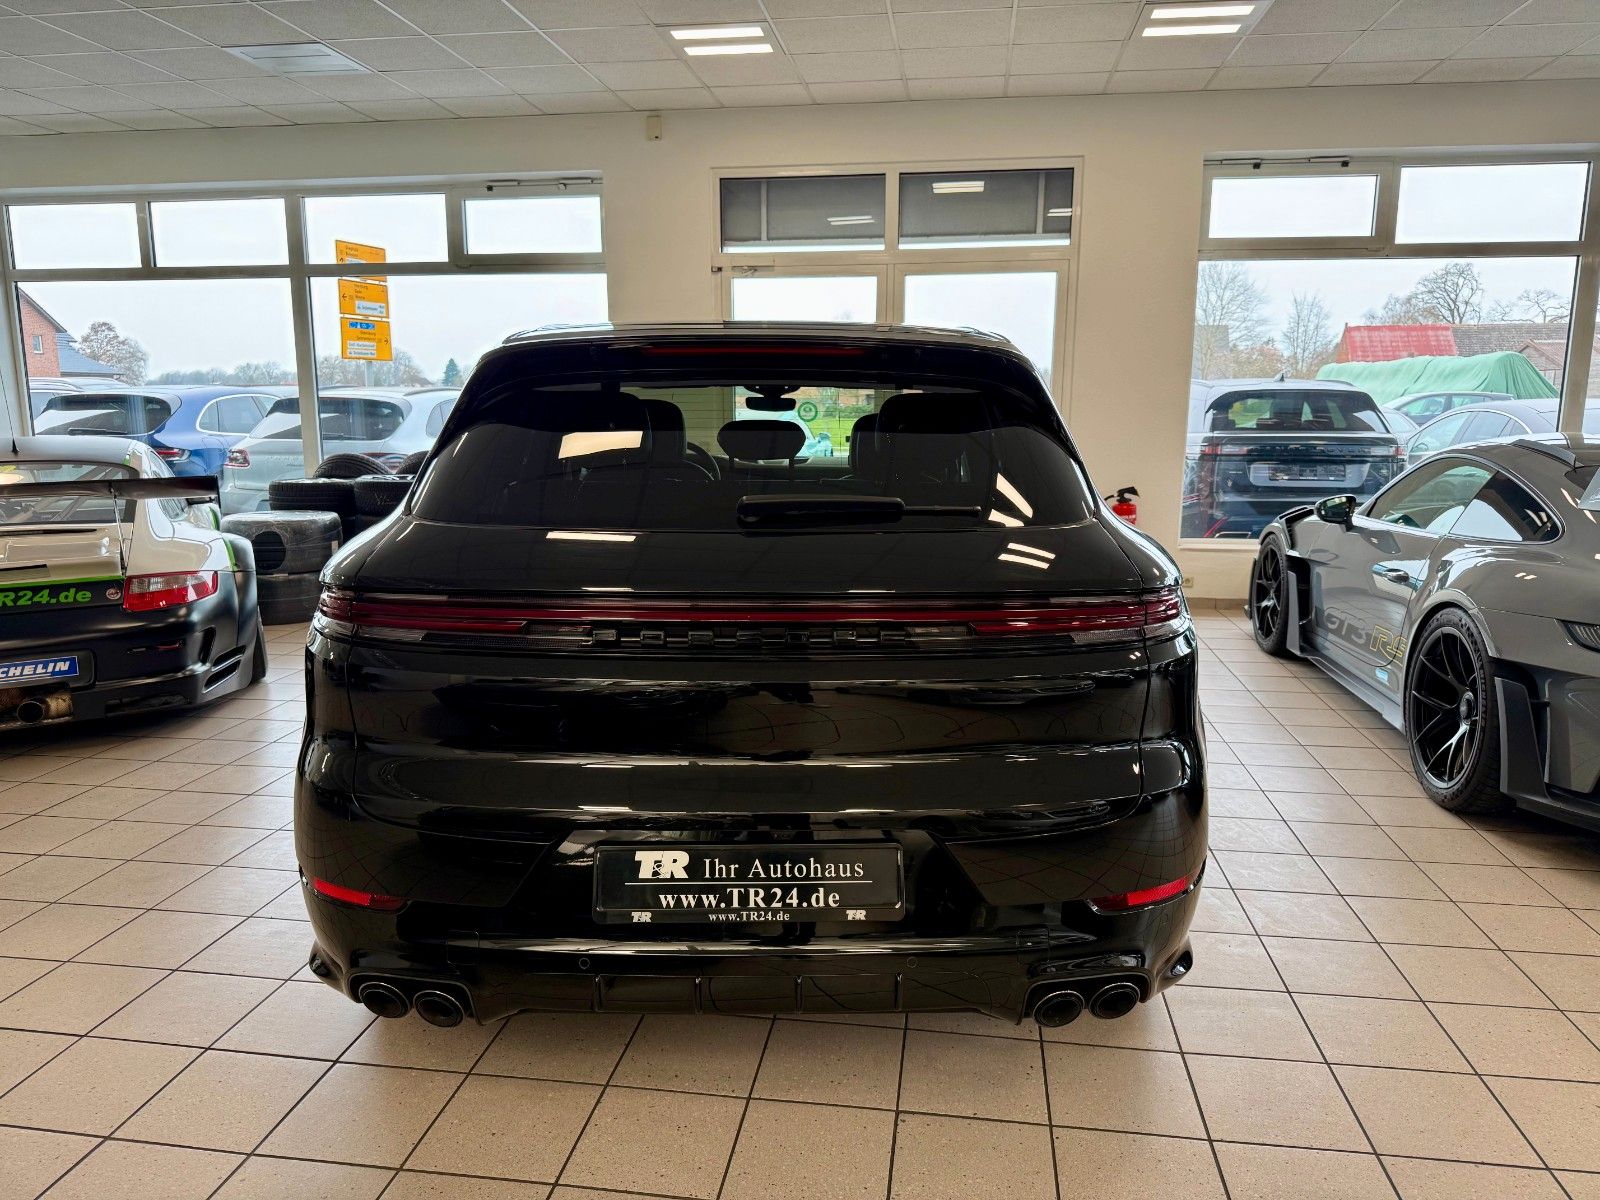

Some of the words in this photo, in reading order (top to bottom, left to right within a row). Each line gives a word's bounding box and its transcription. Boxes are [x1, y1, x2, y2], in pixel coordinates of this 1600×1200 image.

[703, 858, 737, 878] Ihr
[747, 857, 865, 878] Autohaus
[658, 887, 841, 909] www.TR24.de
[708, 910, 791, 921] www.TR24.de
